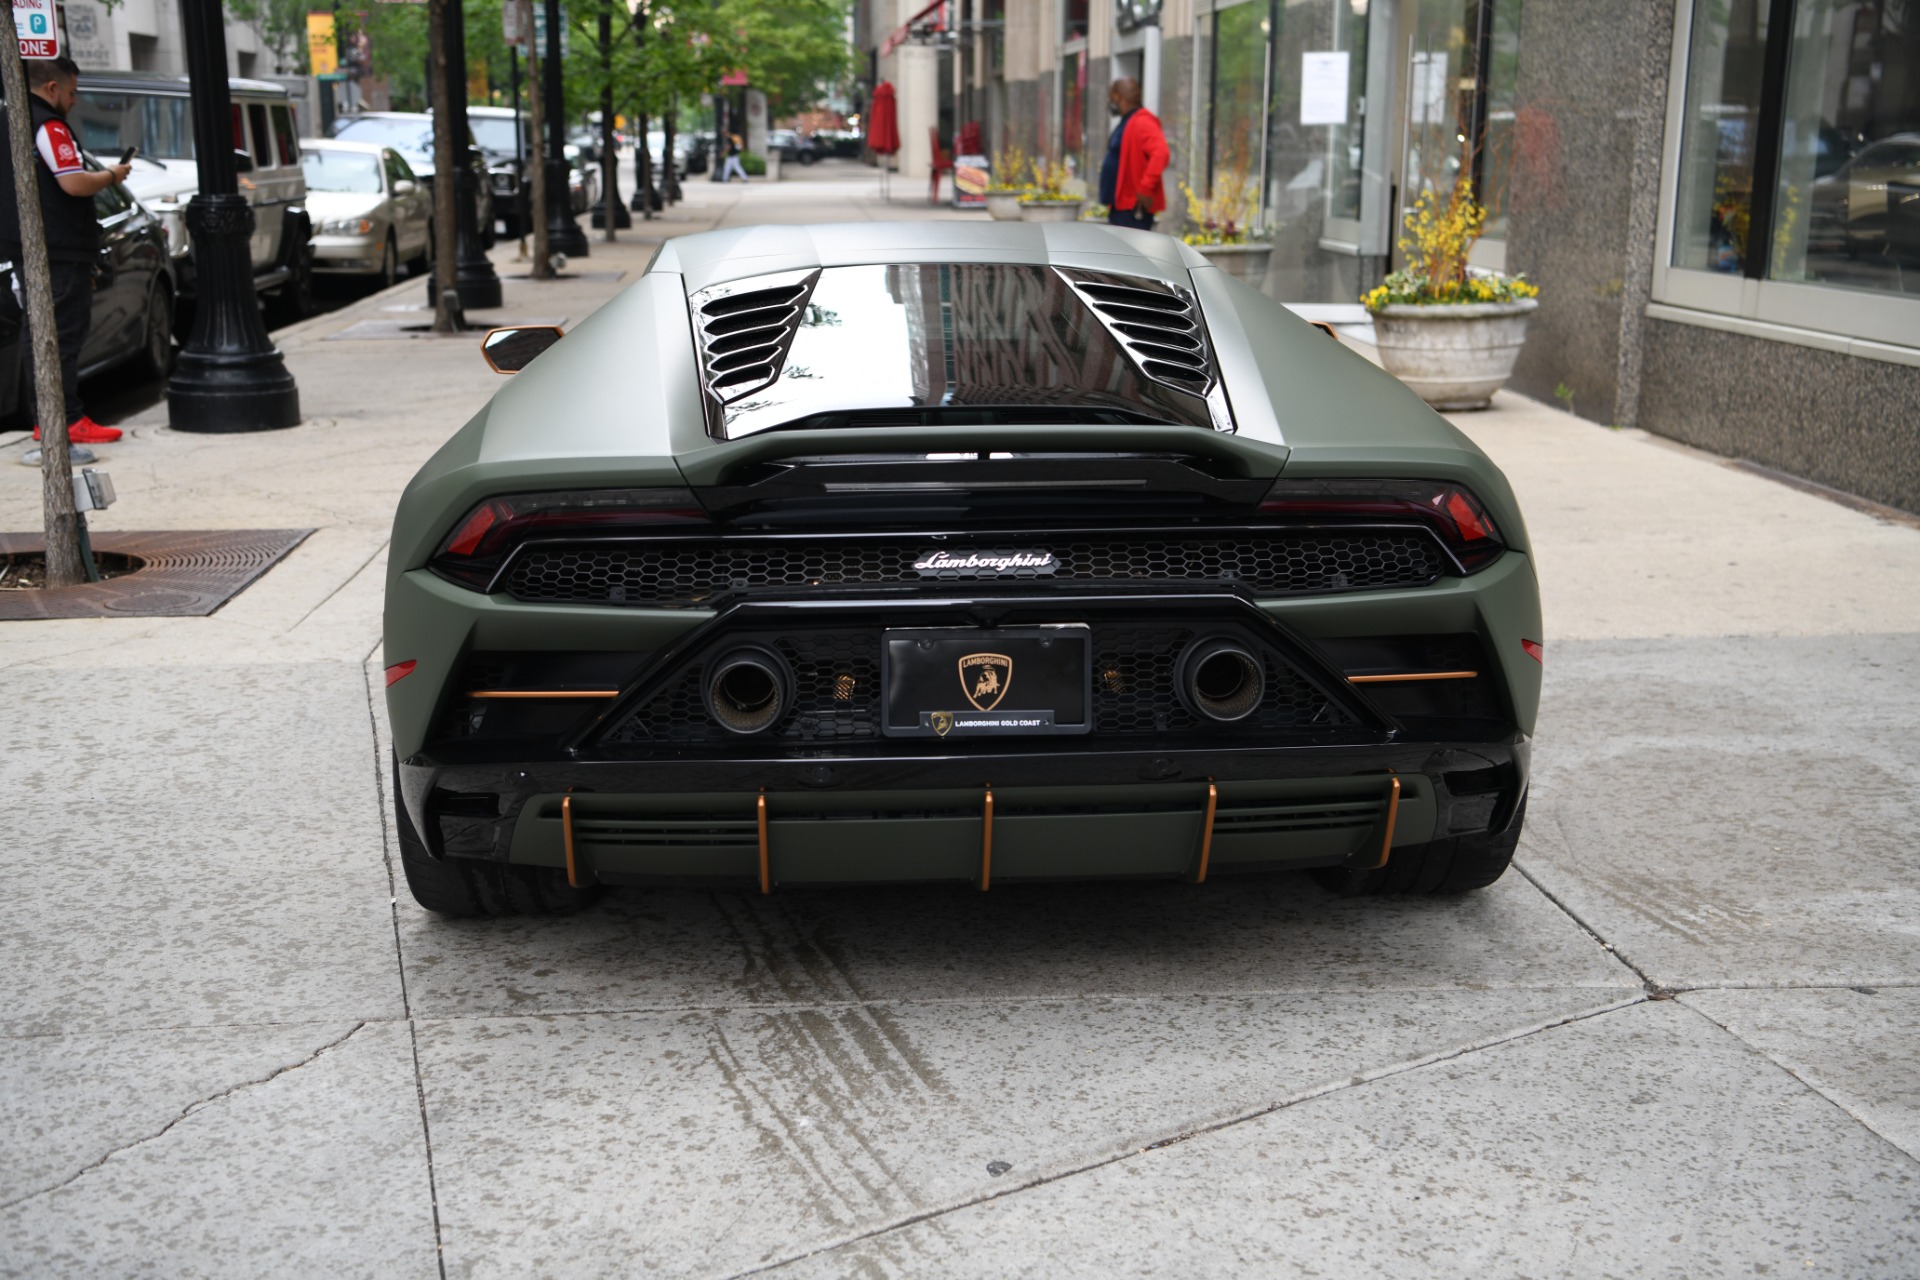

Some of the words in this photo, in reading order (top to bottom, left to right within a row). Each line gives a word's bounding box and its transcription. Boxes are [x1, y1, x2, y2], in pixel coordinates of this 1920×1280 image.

[914, 551, 1052, 571] Lamborghini
[963, 656, 1008, 668] LAMBORGHINI
[1019, 719, 1040, 727] COAST
